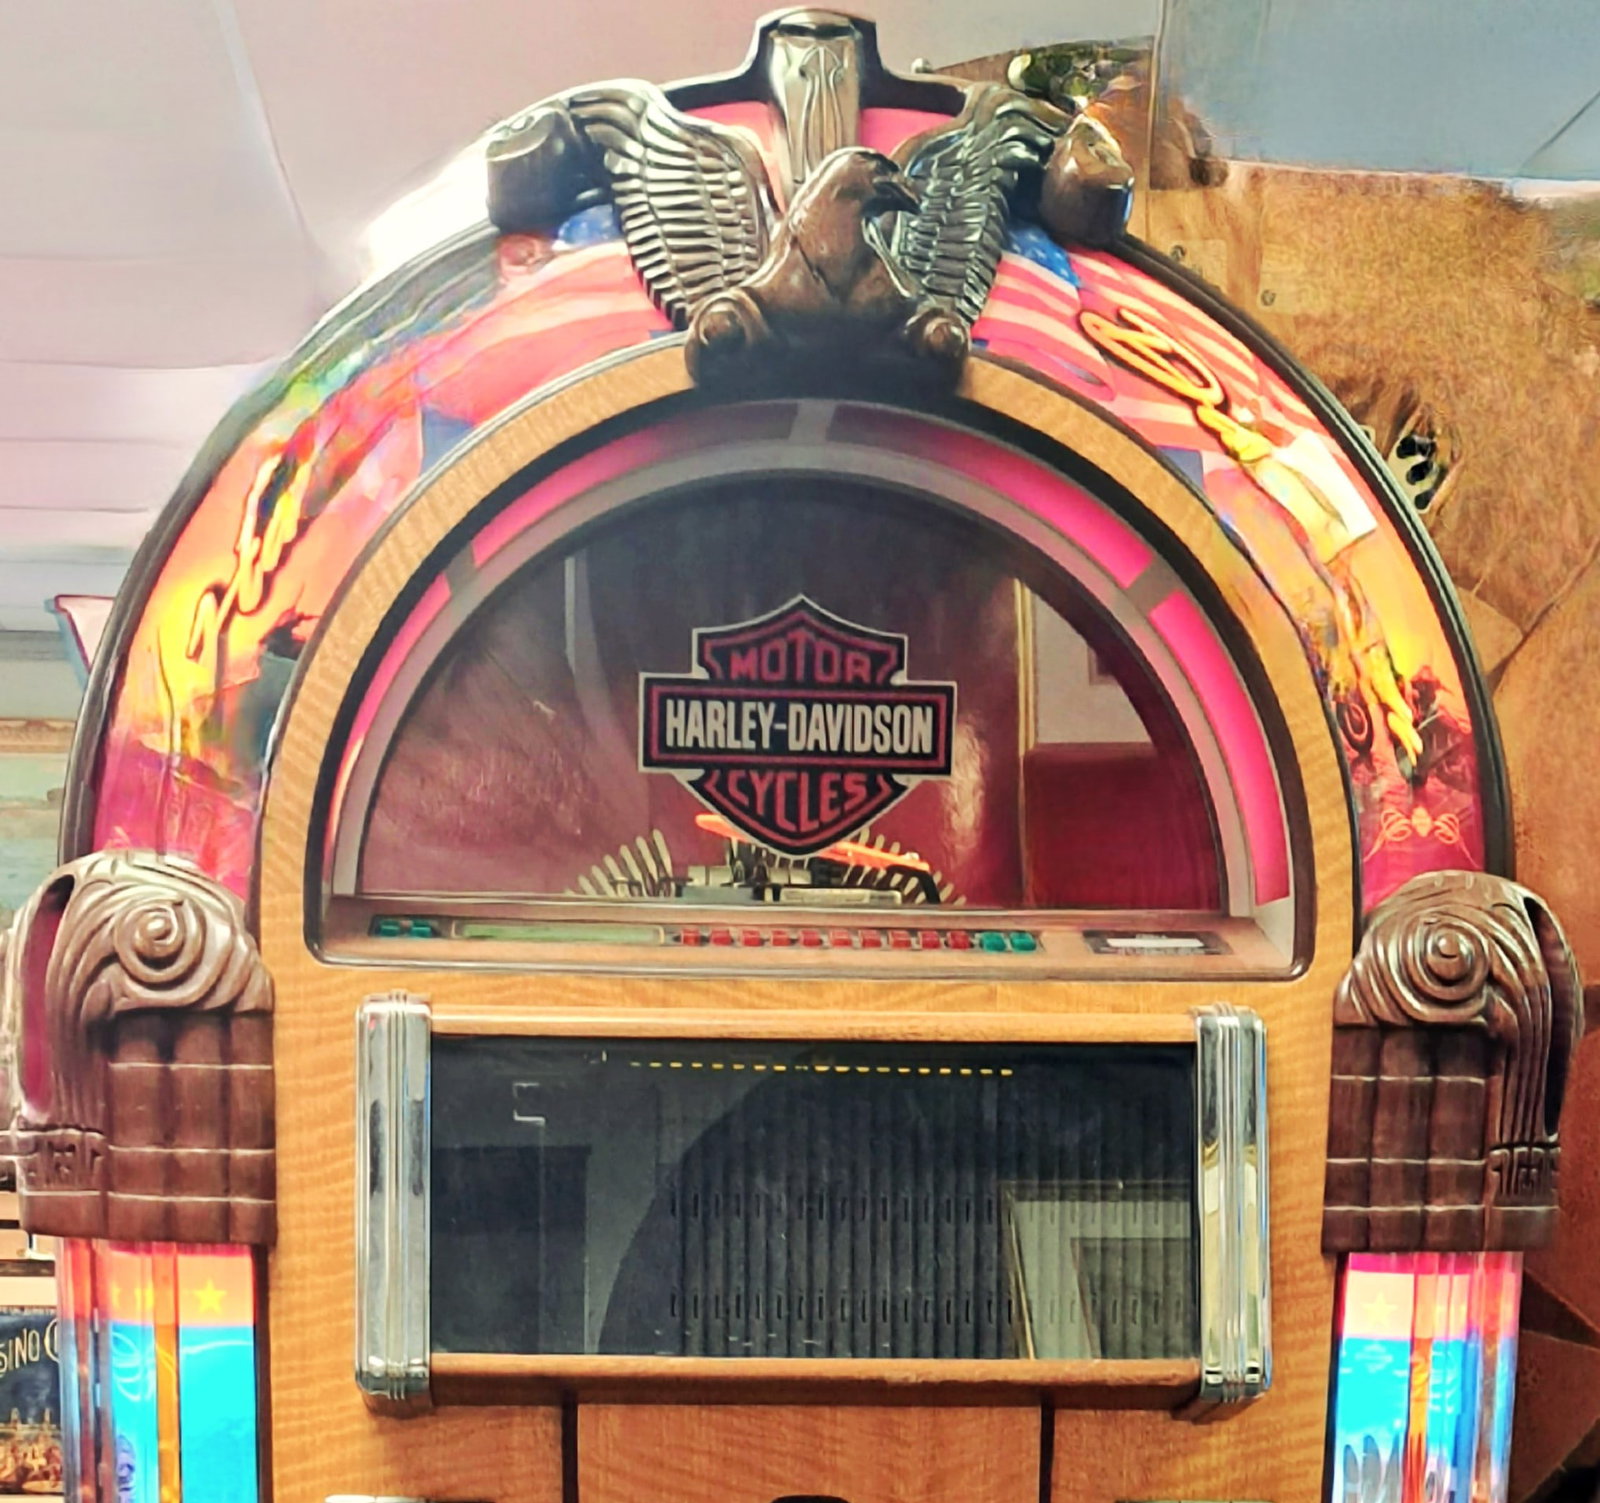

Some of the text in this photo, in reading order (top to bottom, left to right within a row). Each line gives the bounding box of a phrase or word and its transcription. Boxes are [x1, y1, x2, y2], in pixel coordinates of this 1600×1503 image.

[729, 631, 872, 684] MOTOR
[665, 698, 934, 755] HARLEY-DAVIDSON
[727, 769, 868, 833] CYCLES
